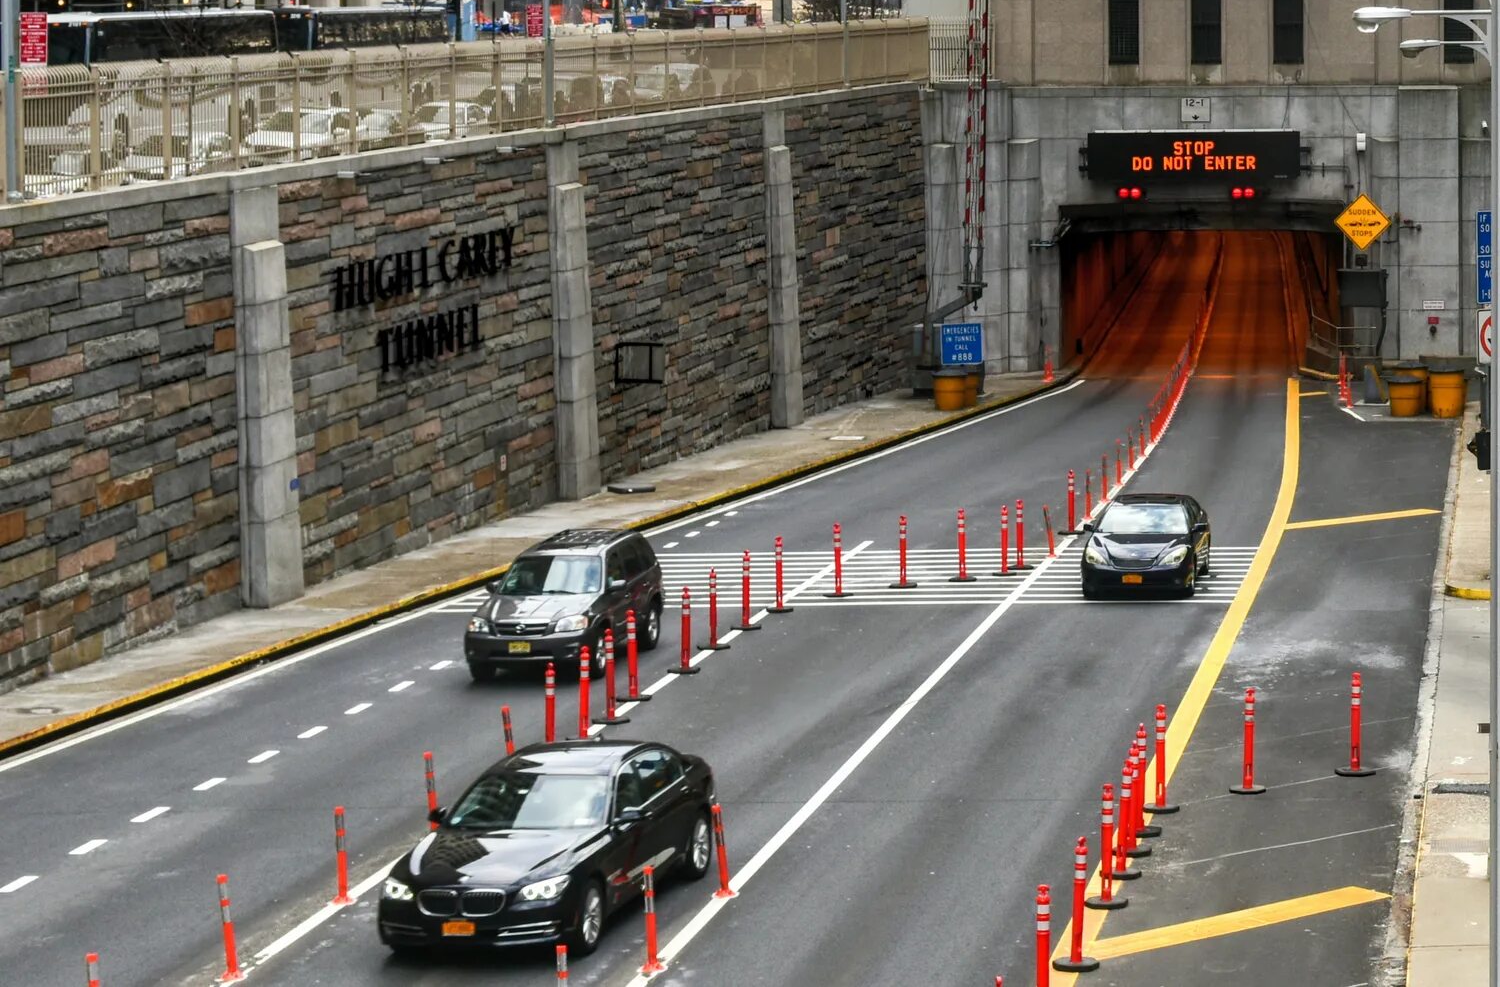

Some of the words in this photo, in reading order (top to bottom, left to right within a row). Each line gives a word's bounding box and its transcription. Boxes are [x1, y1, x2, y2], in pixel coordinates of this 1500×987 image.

[1185, 98, 1204, 107] 12-1
[1173, 141, 1215, 156] STOP
[1132, 157, 1152, 171] DO
[1163, 156, 1193, 171] NOT
[1204, 156, 1256, 171] ENTER
[1348, 208, 1376, 216] SUDDEN
[1479, 214, 1487, 223] IF
[1351, 229, 1373, 237] STOPS
[334, 250, 413, 312] HUGH
[438, 226, 515, 284] CAREY
[943, 326, 979, 335] EMERGENCIES
[376, 303, 485, 373] TUNNEL
[951, 352, 973, 361] #888
